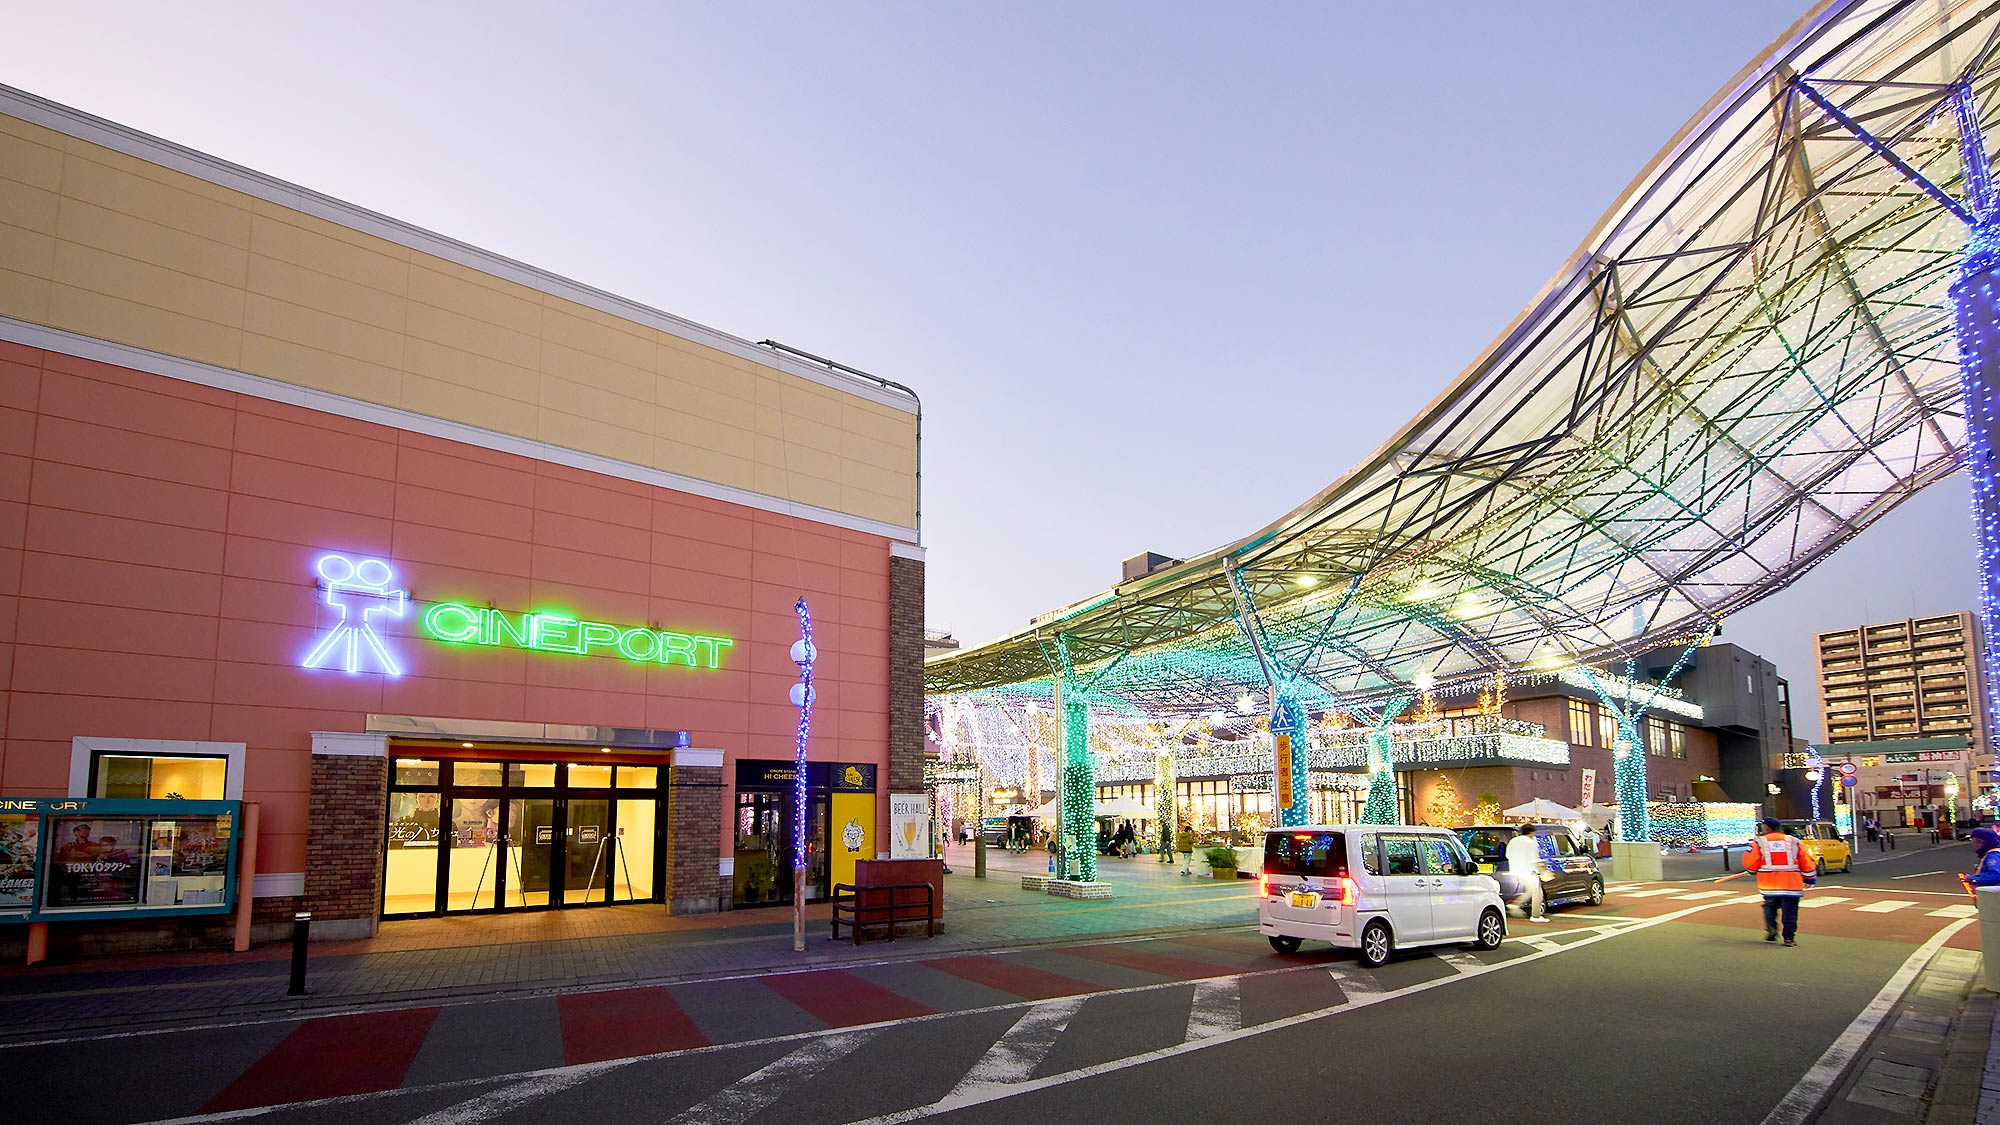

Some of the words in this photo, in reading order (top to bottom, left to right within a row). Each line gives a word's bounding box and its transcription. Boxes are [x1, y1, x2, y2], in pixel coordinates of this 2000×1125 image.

[425, 602, 733, 669] CINEPORT
[1279, 741, 1290, 804] 歩行者注意
[893, 802, 909, 815] BEER
[910, 802, 927, 815] HALL
[66, 861, 131, 874] TOKYOタクシー
